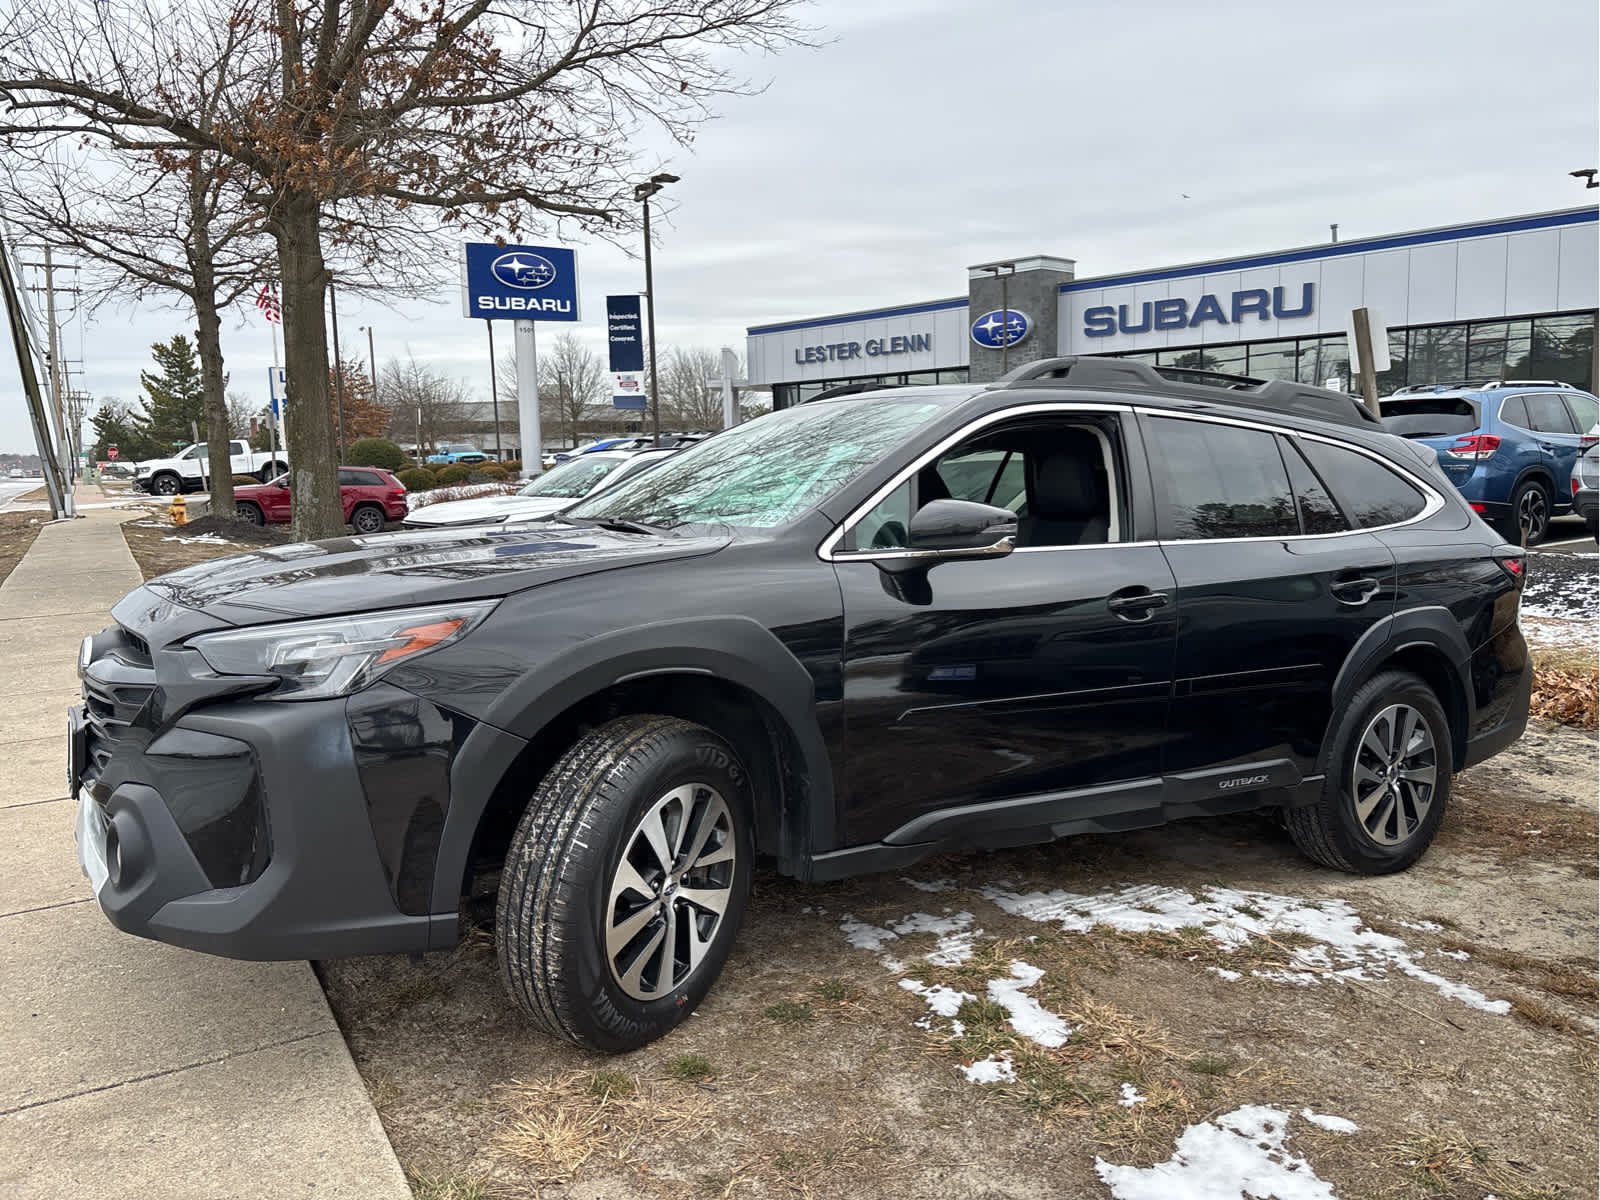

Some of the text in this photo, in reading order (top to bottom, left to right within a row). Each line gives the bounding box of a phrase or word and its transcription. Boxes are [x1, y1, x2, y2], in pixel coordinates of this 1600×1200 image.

[478, 296, 571, 312] SUBARU
[1083, 282, 1314, 337] SUBARU
[795, 333, 931, 365] LESTER GLENN
[1218, 774, 1270, 789] OUTBACK
